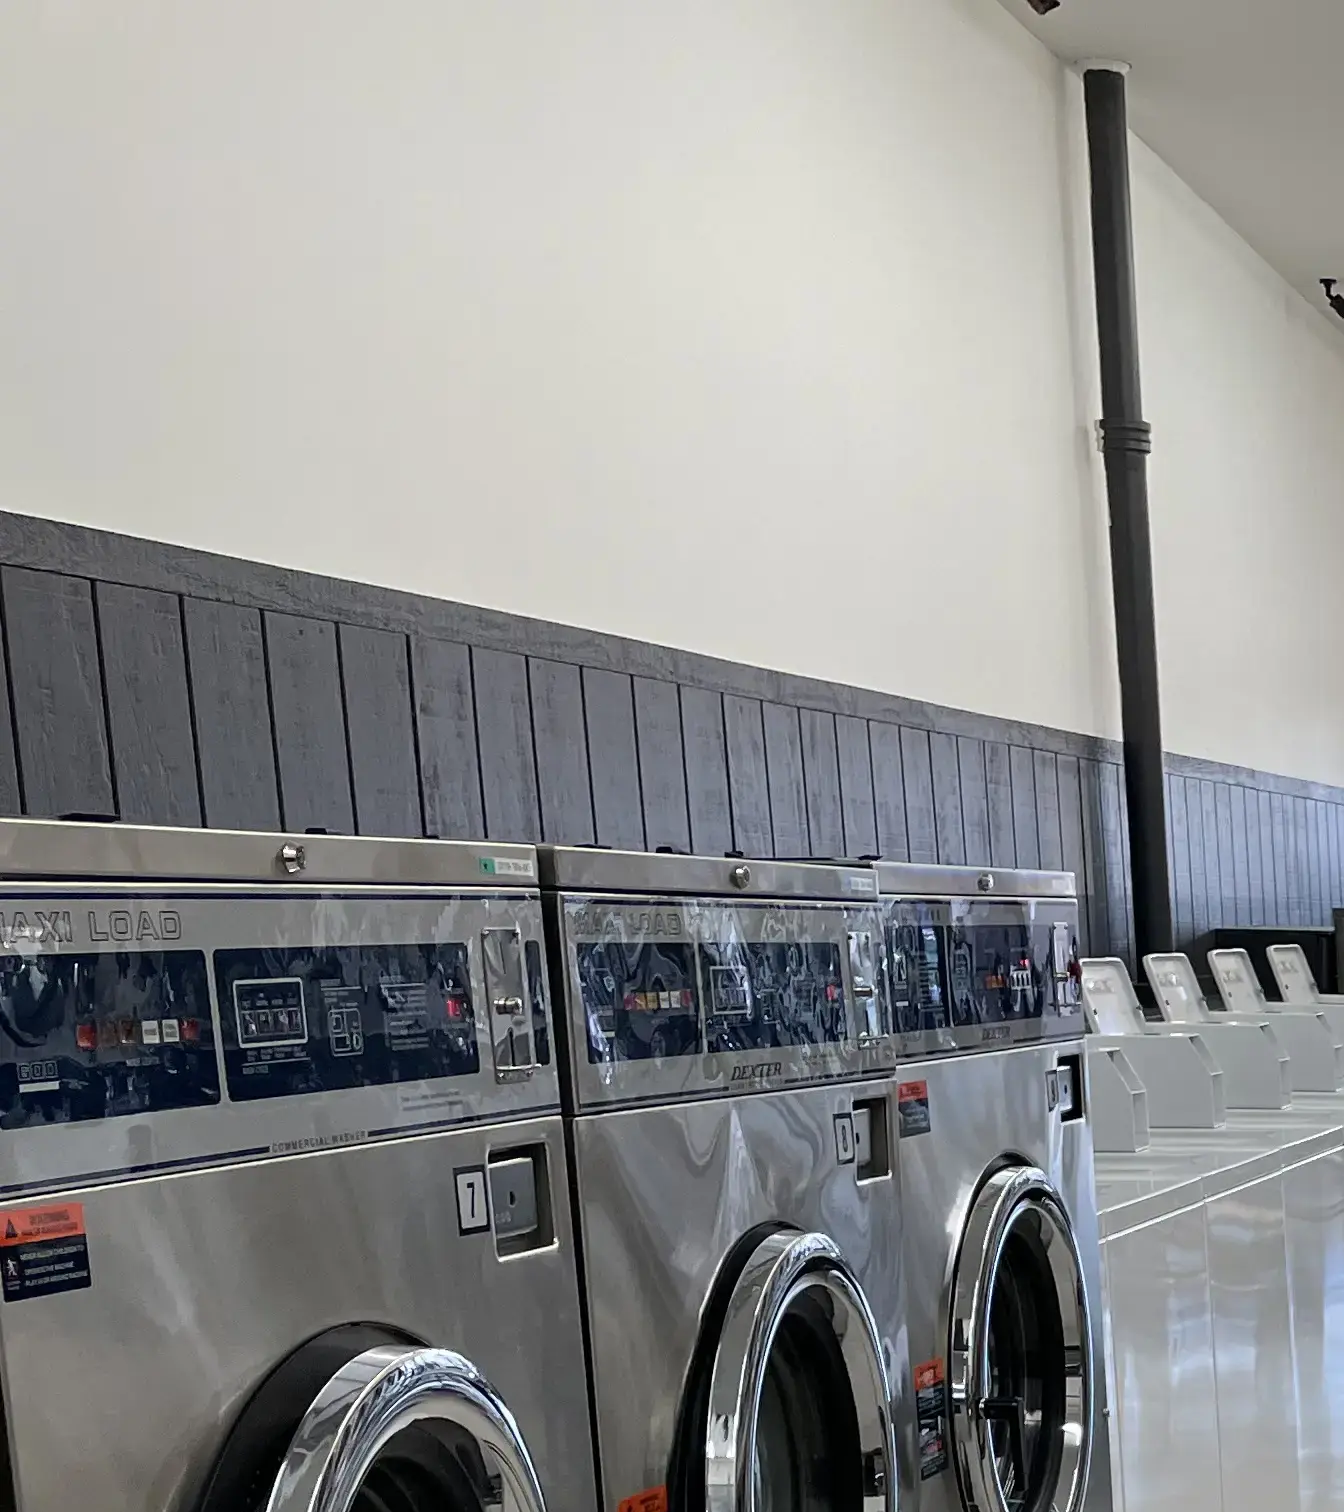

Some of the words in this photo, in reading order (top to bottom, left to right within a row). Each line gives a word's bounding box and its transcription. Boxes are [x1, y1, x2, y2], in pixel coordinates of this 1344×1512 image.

[88, 911, 183, 942] LOAD
[730, 1062, 782, 1081] DEXTER
[271, 1137, 330, 1153] COMMERCIAL
[331, 1130, 366, 1145] WASHER
[466, 1181, 476, 1218] 7
